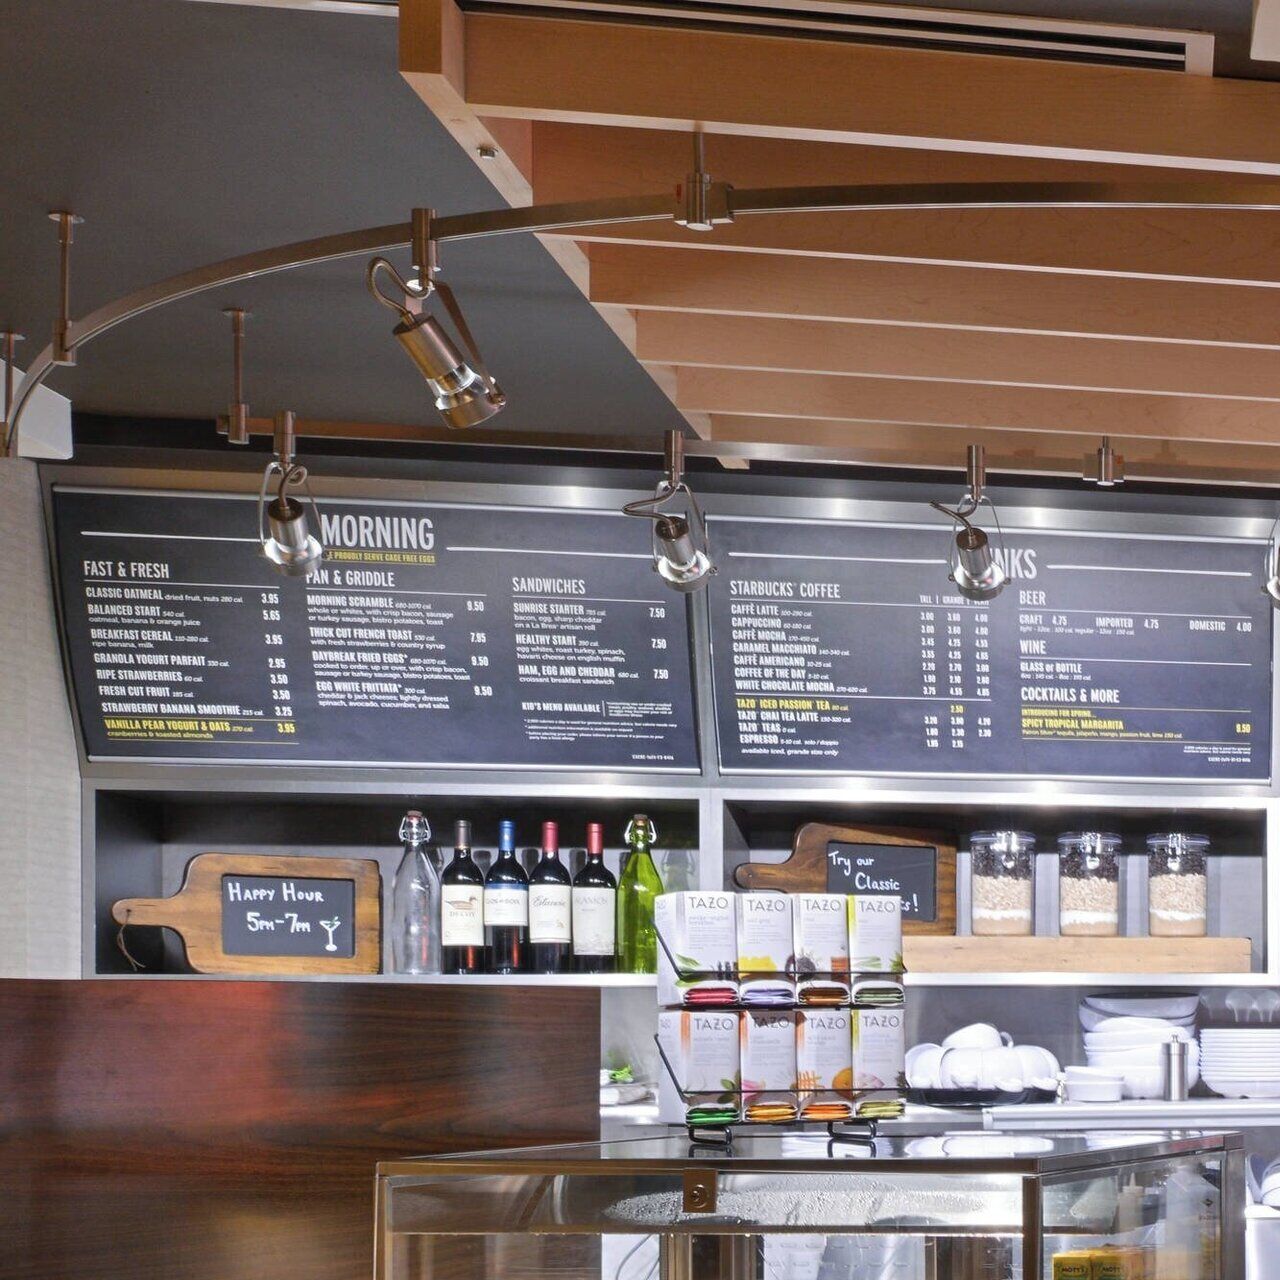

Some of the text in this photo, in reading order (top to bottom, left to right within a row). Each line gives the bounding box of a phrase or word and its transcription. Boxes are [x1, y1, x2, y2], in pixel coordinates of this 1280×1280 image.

[321, 514, 434, 550] MORNING
[84, 561, 169, 579] FAST & FRESH
[306, 570, 395, 586] PAN & GRIDDLE
[512, 577, 586, 594] SANDWICHES
[730, 581, 841, 599] STARBUCKS COFFEE
[86, 587, 122, 599] CLASSIC
[124, 588, 163, 600] OATMEAL
[262, 594, 279, 604] 3.95
[1019, 590, 1046, 606] BEER
[307, 595, 393, 608] MORNING SCRAMBLE
[88, 604, 161, 617] BALANCED START
[263, 610, 280, 620] 5.65
[513, 603, 584, 615] SUNRISE STARTER
[650, 608, 665, 618] 7.50
[757, 605, 779, 616] LATTE
[732, 618, 781, 629] CAPPUCCINO
[1019, 615, 1042, 625] CRAFT
[1052, 615, 1067, 626] 4.75
[1096, 617, 1134, 628] IMPORTED
[1144, 618, 1159, 629] 4.75
[1190, 620, 1226, 631] DOMESTIC
[91, 629, 173, 642] BREAKFAST CEREAL
[265, 635, 282, 645] 3.95
[309, 627, 413, 641] THICK CUT FRENCH TOAST
[471, 632, 486, 643] 7.95
[516, 634, 576, 646] HEALTHY START
[758, 631, 786, 642] MOCHA
[652, 639, 667, 649] 7.50
[733, 642, 817, 655] CARAMEL MACCHIATO
[1020, 640, 1046, 655] WINE
[94, 652, 205, 667] GRANOLA YOGURT PARFAIT
[268, 658, 286, 669] 2.95
[312, 651, 356, 663] DAYBREAK
[357, 652, 381, 663] FRIED
[518, 665, 615, 678] HAM, EGG AND CHEDDAR
[654, 669, 668, 680] 7.50
[1020, 662, 1044, 673] GLASS
[1055, 663, 1082, 674] BOTTLE
[96, 669, 183, 682] RIPE STRAWBERRIES
[270, 674, 288, 685] 3.50
[99, 686, 170, 698] FRESH CUT FRUIT
[316, 681, 332, 692] EGG
[334, 682, 361, 693] WHITE
[735, 680, 835, 693] WHITE CHOCOLATE MOCHA
[273, 689, 290, 700] 3.50
[1021, 687, 1120, 704] COCKTAILS & MORE
[102, 702, 241, 716] STRAWBERRY BANANA SMOOTHIE
[275, 706, 292, 717] 3.25
[522, 702, 541, 712] KID'S
[543, 702, 563, 712] MENU
[564, 703, 600, 713] AVAILABLE
[105, 719, 230, 732] VANILLA PEAR YOGURT & OATS
[277, 723, 295, 734] 3.95
[1022, 718, 1124, 731] SPICY TROPICAL MARGARITA
[828, 851, 874, 876] Try our
[855, 871, 900, 891] Classic
[688, 896, 729, 910] TAZO
[747, 898, 786, 912] TAZO
[803, 898, 842, 912] TAZO
[858, 899, 896, 913] TAZO
[694, 1017, 734, 1031] TAZO
[751, 1016, 790, 1030] TAZO
[808, 1017, 847, 1031] TAZO
[863, 1015, 900, 1028] TAZO
